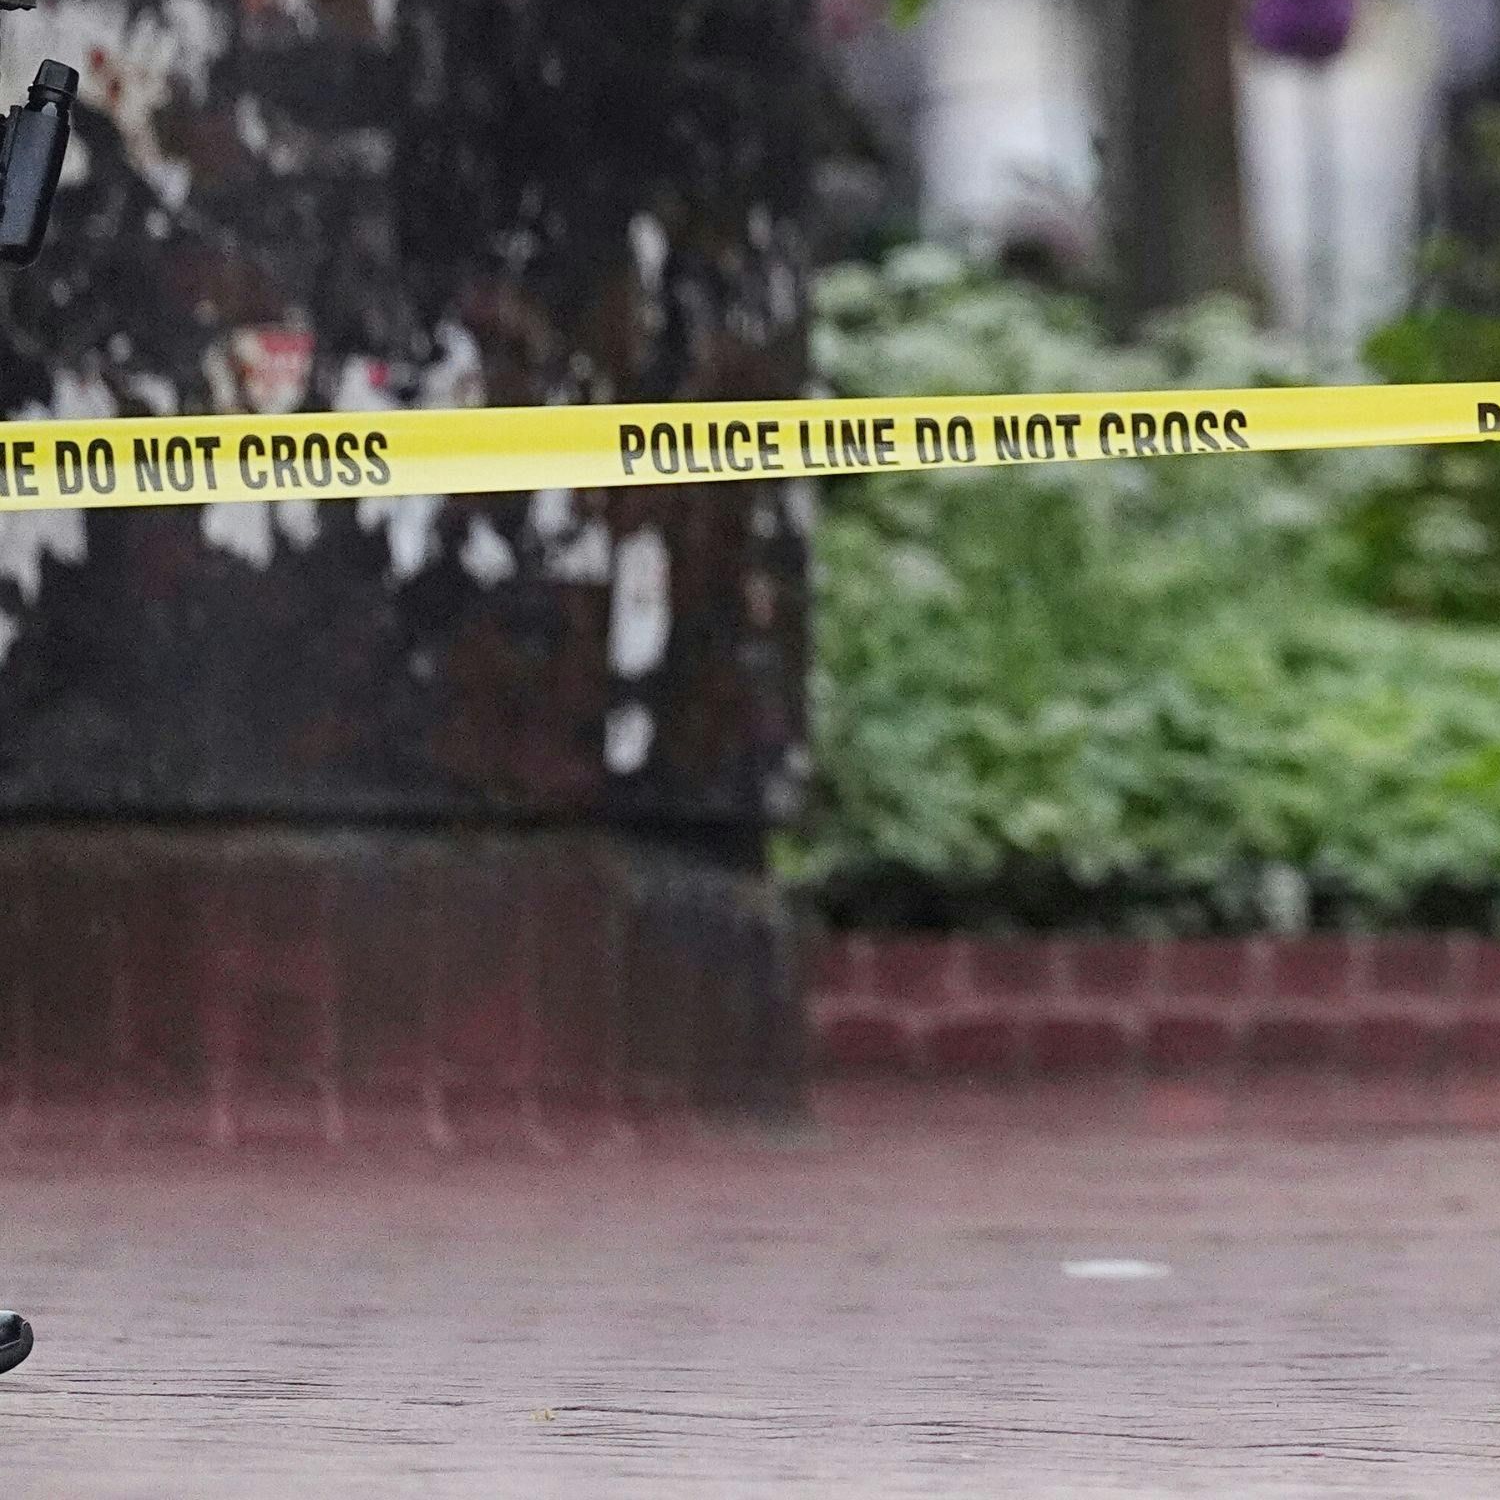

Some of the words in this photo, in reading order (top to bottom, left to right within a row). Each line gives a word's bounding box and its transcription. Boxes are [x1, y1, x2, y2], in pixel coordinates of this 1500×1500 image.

[55, 438, 116, 495] DO
[133, 435, 220, 492] NOT
[238, 431, 391, 490] CROSS
[619, 419, 784, 476] POLICE
[799, 418, 901, 469] LINE
[914, 415, 976, 464] DO
[993, 413, 1081, 462] NOT
[1099, 409, 1250, 457] CROSS
